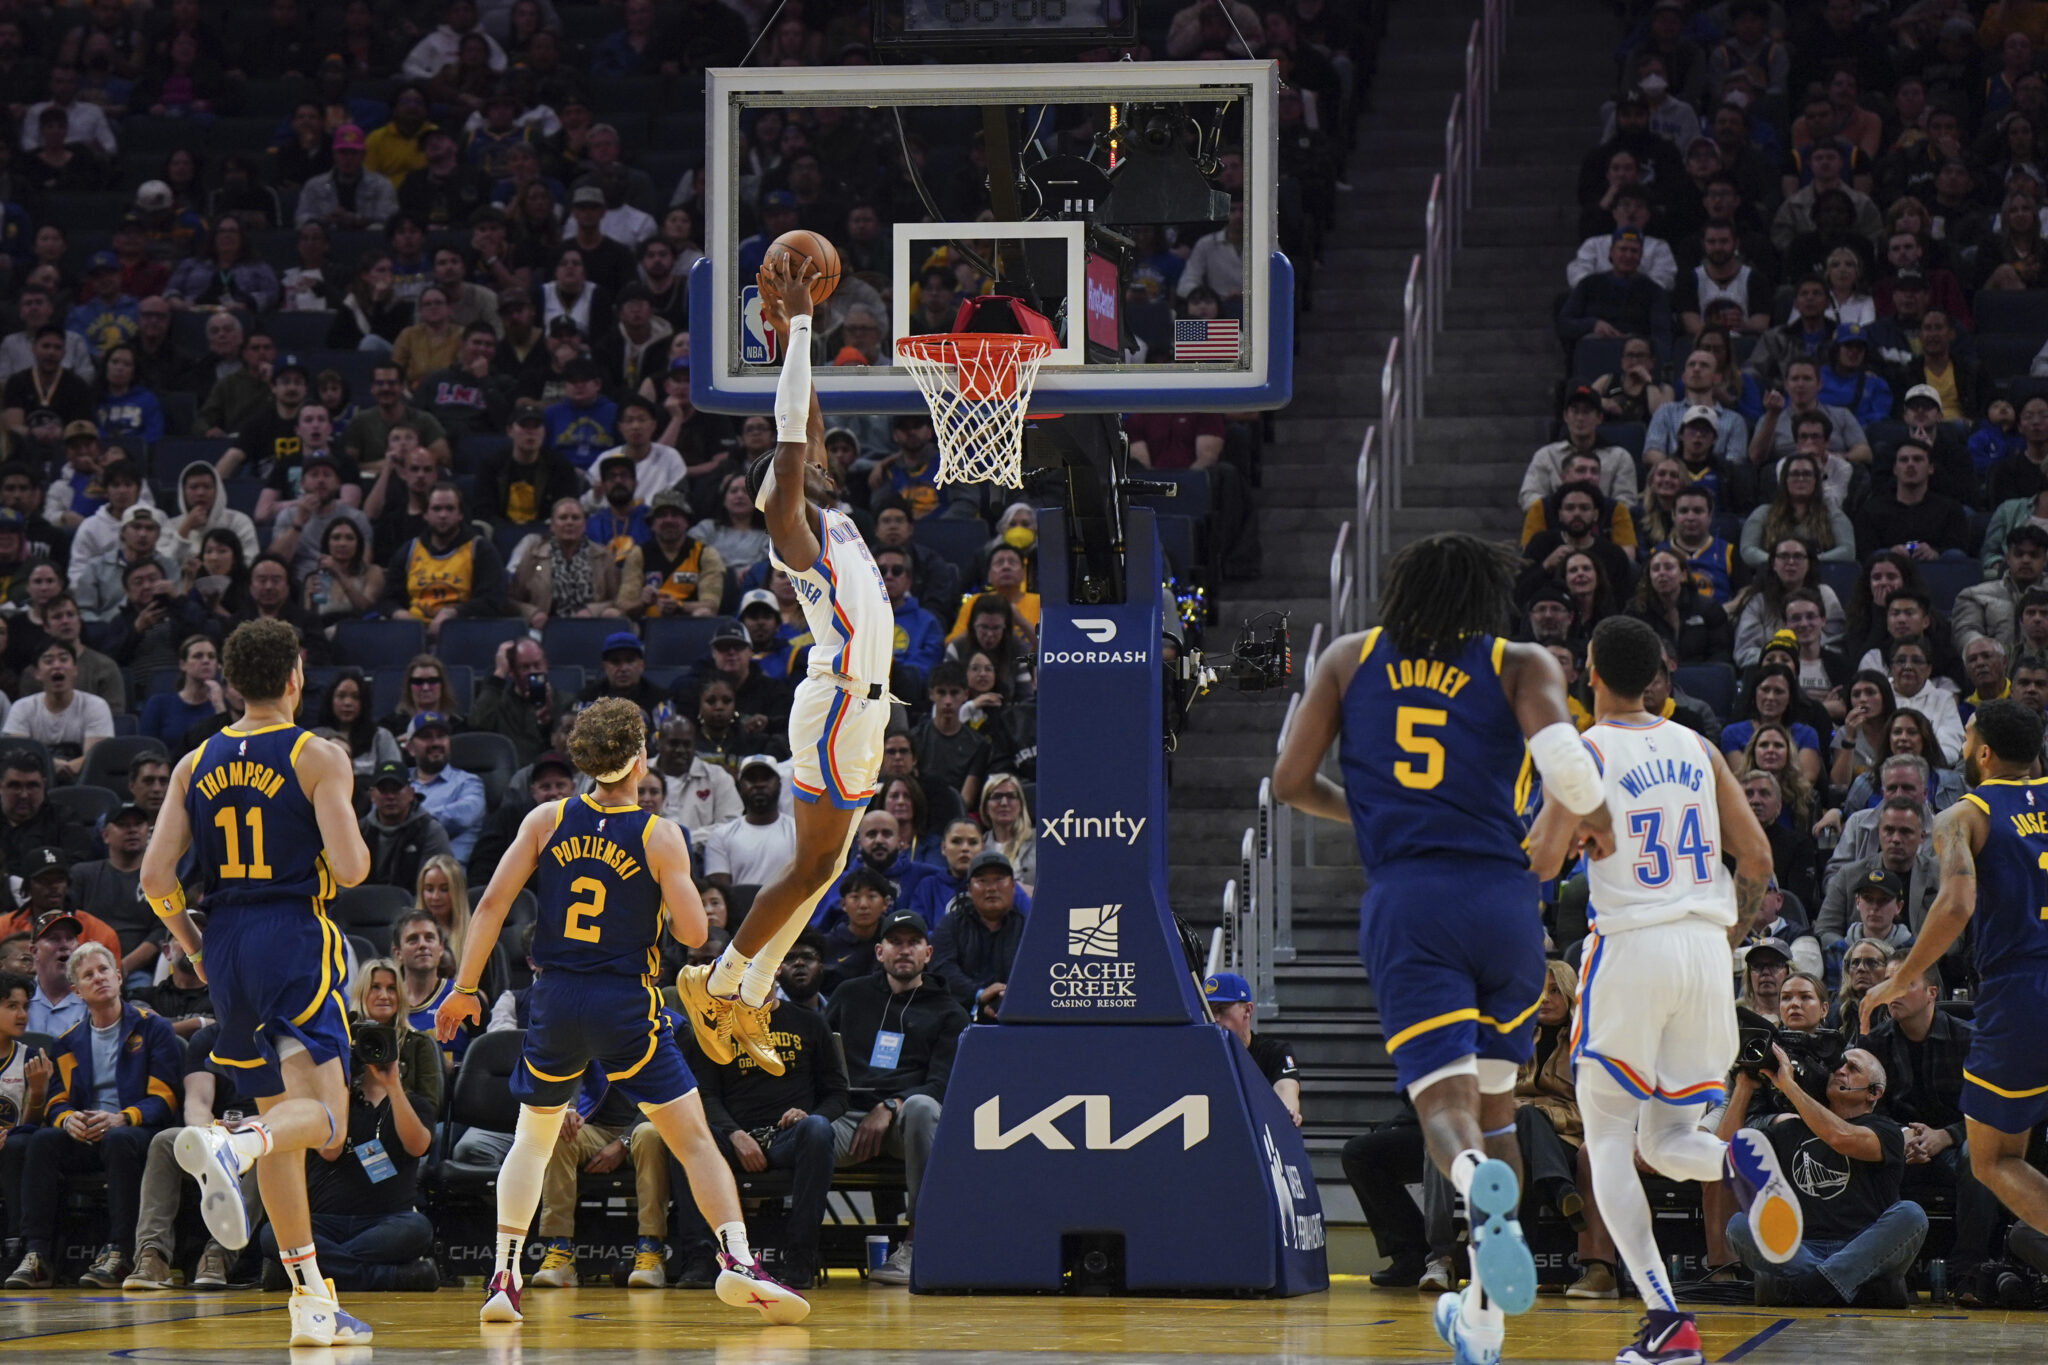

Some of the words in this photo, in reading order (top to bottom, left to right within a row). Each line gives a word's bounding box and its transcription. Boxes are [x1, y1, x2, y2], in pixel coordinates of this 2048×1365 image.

[747, 346, 763, 358] NBA
[1043, 651, 1147, 664] DOORDASH
[1386, 658, 1471, 698] LOONEY
[1393, 706, 1448, 790] 5
[196, 761, 286, 800] THOMPSON
[1618, 759, 1703, 798] WILLIAMS
[214, 806, 273, 880] 11
[1041, 809, 1147, 846] xfinity
[1626, 803, 1715, 889] 34
[551, 835, 642, 881] PODZIEMSKI
[563, 875, 607, 944] 2
[1049, 963, 1136, 979] CACHE
[1049, 980, 1137, 997] CREEK
[1051, 999, 1092, 1008] CASINO
[1096, 999, 1137, 1008] RESORT
[974, 1094, 1210, 1151] KIA
[449, 1245, 498, 1260] CHA
[575, 1245, 635, 1260] CHAS
